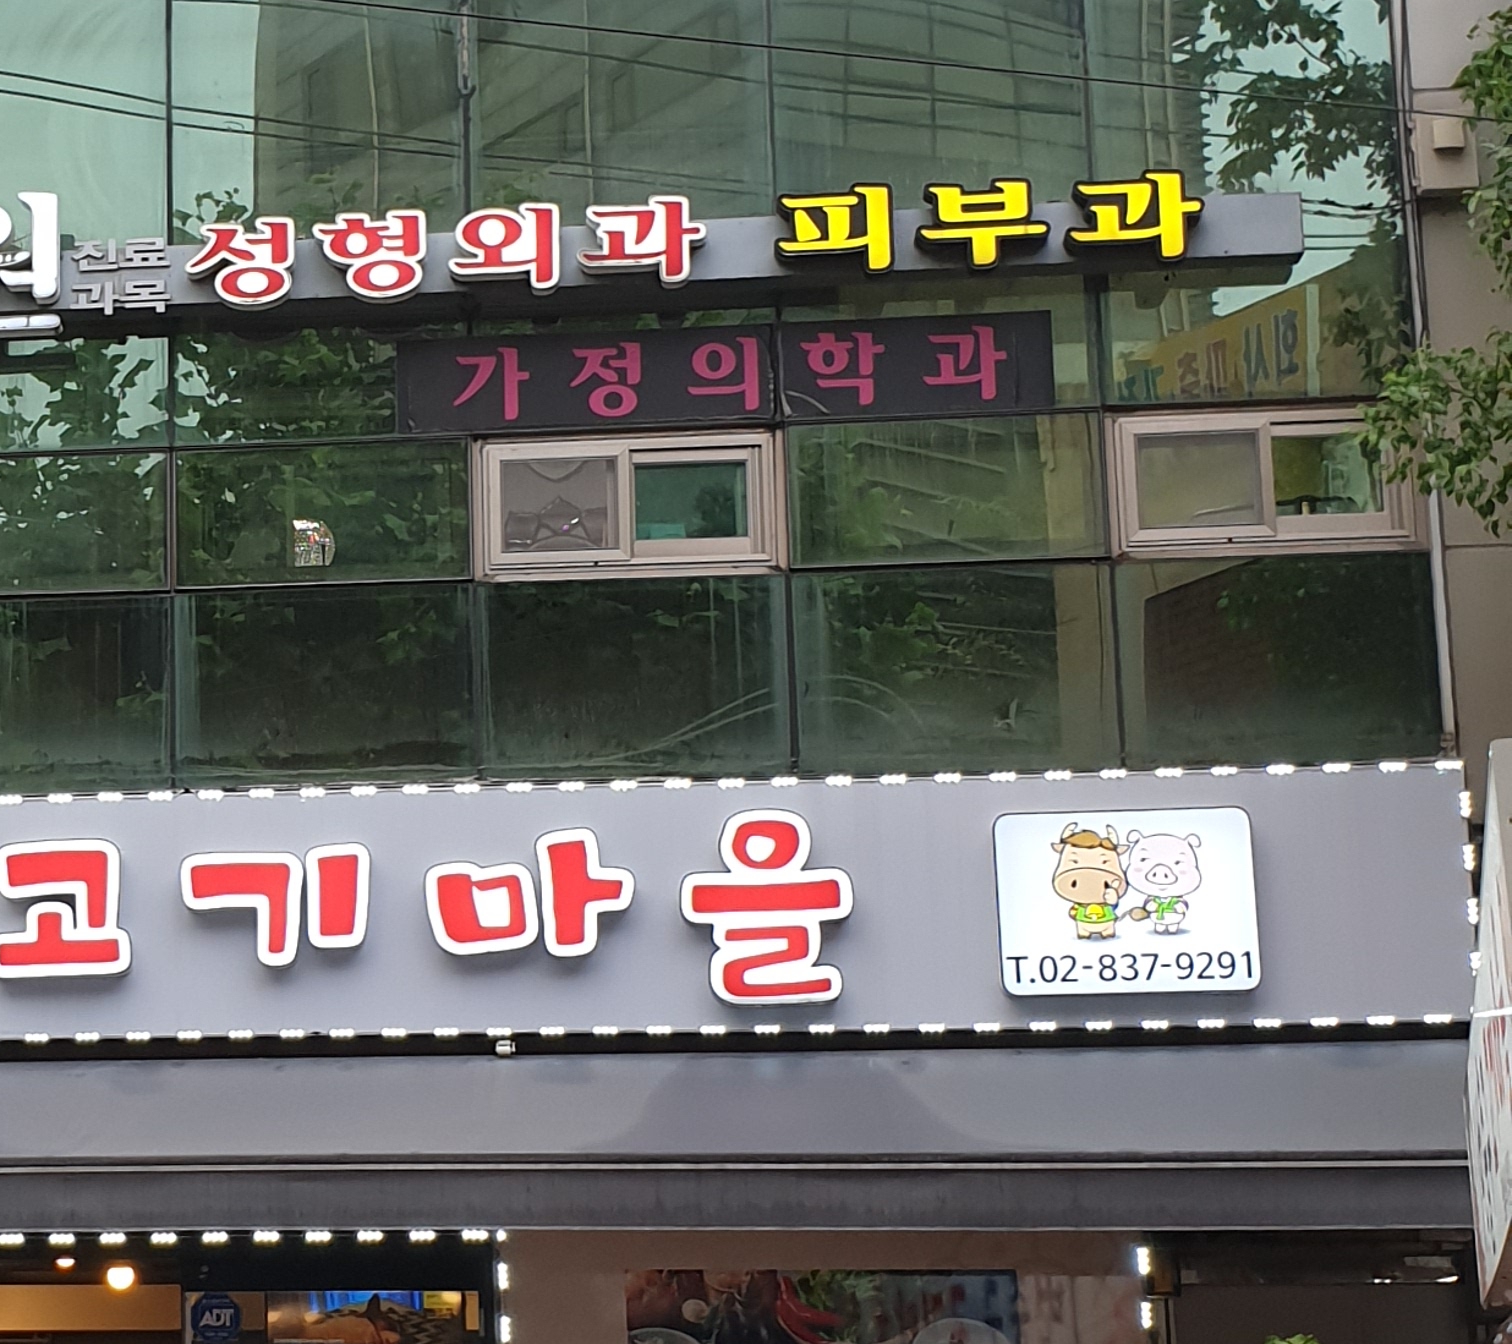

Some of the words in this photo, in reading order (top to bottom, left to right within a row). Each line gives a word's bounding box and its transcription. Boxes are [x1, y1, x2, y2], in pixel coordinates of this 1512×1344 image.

[71, 236, 171, 272] 진료
[185, 195, 706, 308] 성형외과
[776, 170, 1204, 272] 피부과
[70, 278, 171, 315] 과목
[453, 325, 1007, 421] 가정의학과
[199, 1308, 234, 1328] ADT
